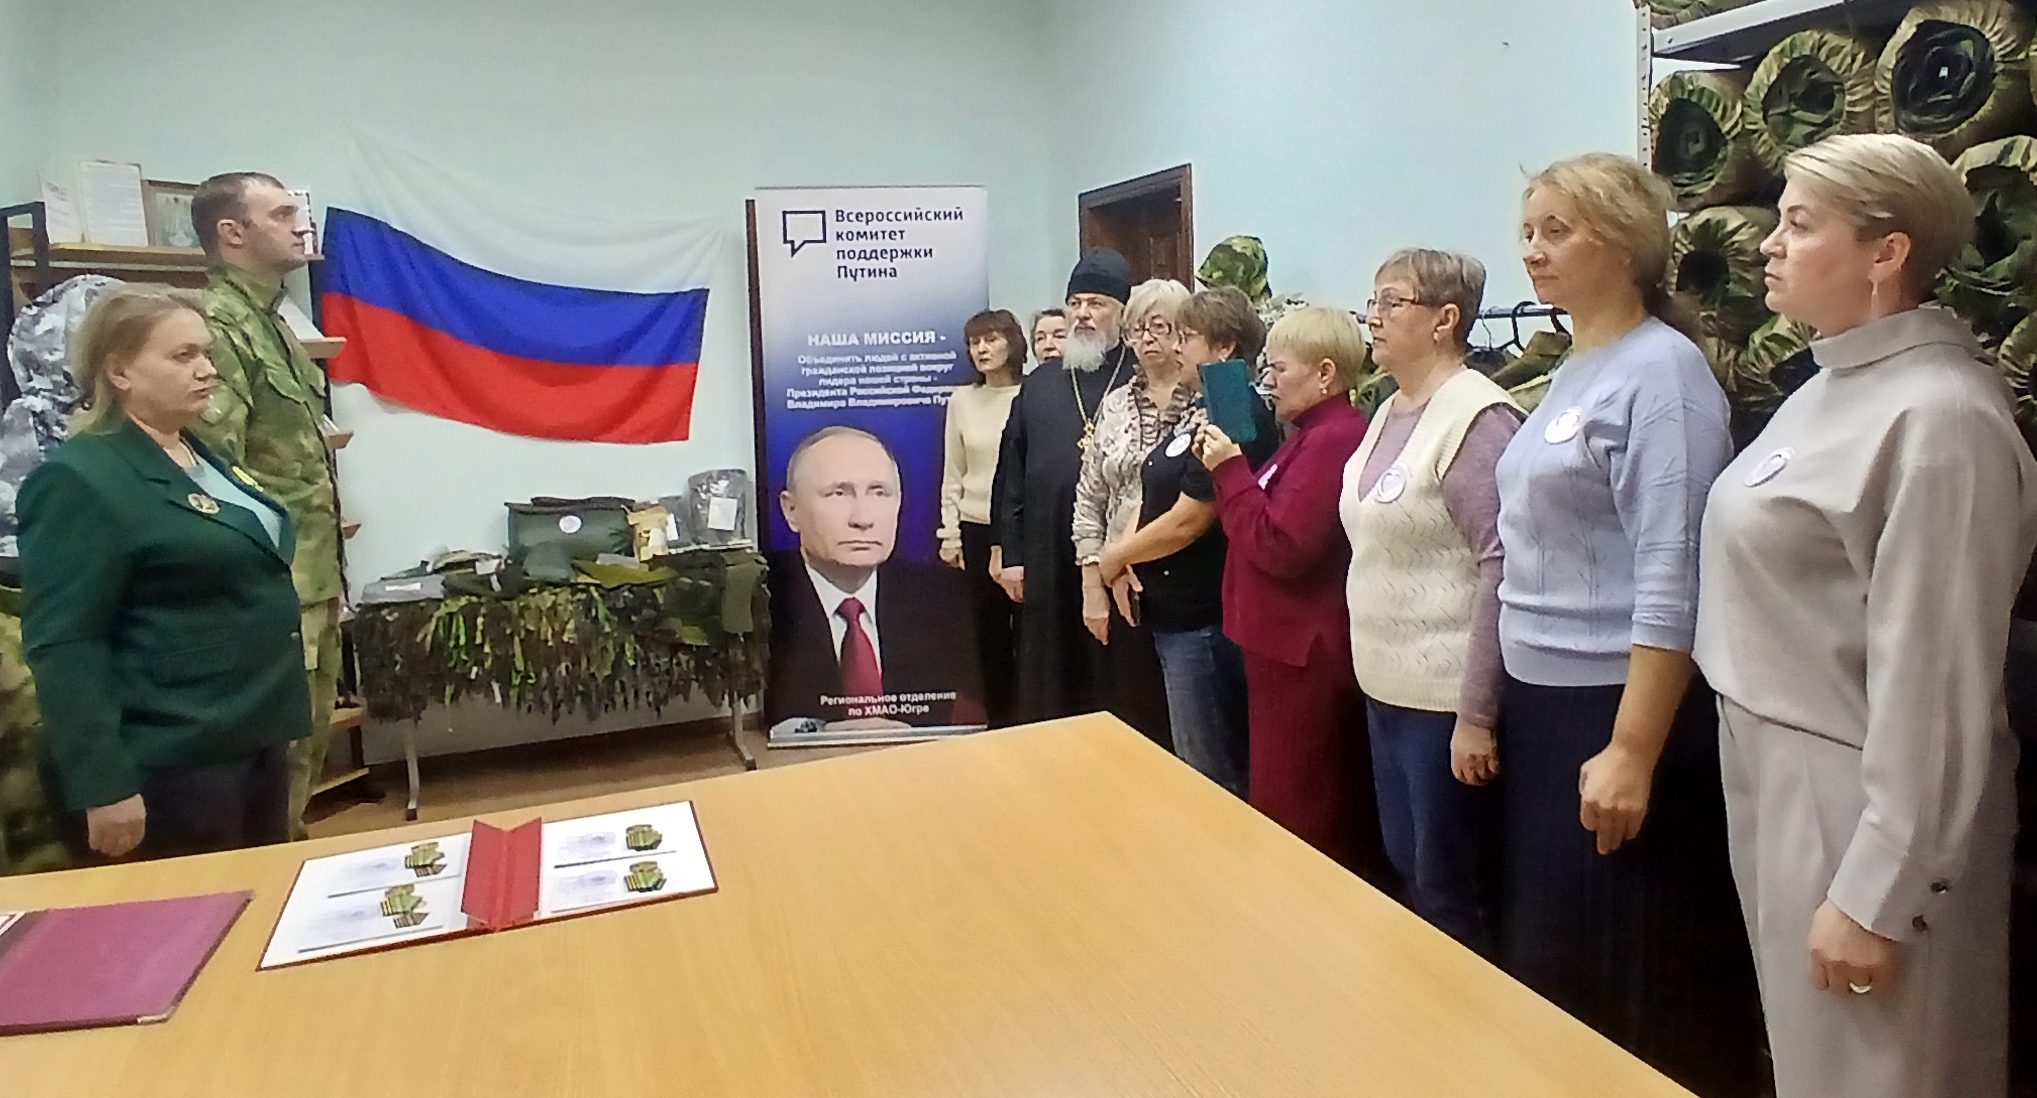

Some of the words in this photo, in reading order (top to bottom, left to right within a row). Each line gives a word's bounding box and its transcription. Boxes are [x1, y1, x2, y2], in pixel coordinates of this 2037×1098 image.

[835, 207, 963, 226] Всероссийский
[835, 229, 906, 242] комитет
[836, 247, 933, 263] поддержки
[837, 265, 898, 282] Путина
[807, 333, 859, 347] НАША
[864, 330, 936, 345] МИССИЯ
[865, 353, 898, 363] людей
[801, 364, 867, 376] гражданской
[818, 376, 857, 386] лидера
[786, 388, 847, 399] Президента
[786, 399, 847, 409] Владимира
[820, 695, 897, 706] Региональное
[899, 690, 957, 703] отделение
[848, 706, 863, 717] по
[864, 703, 930, 717] ХМАО-Югре
